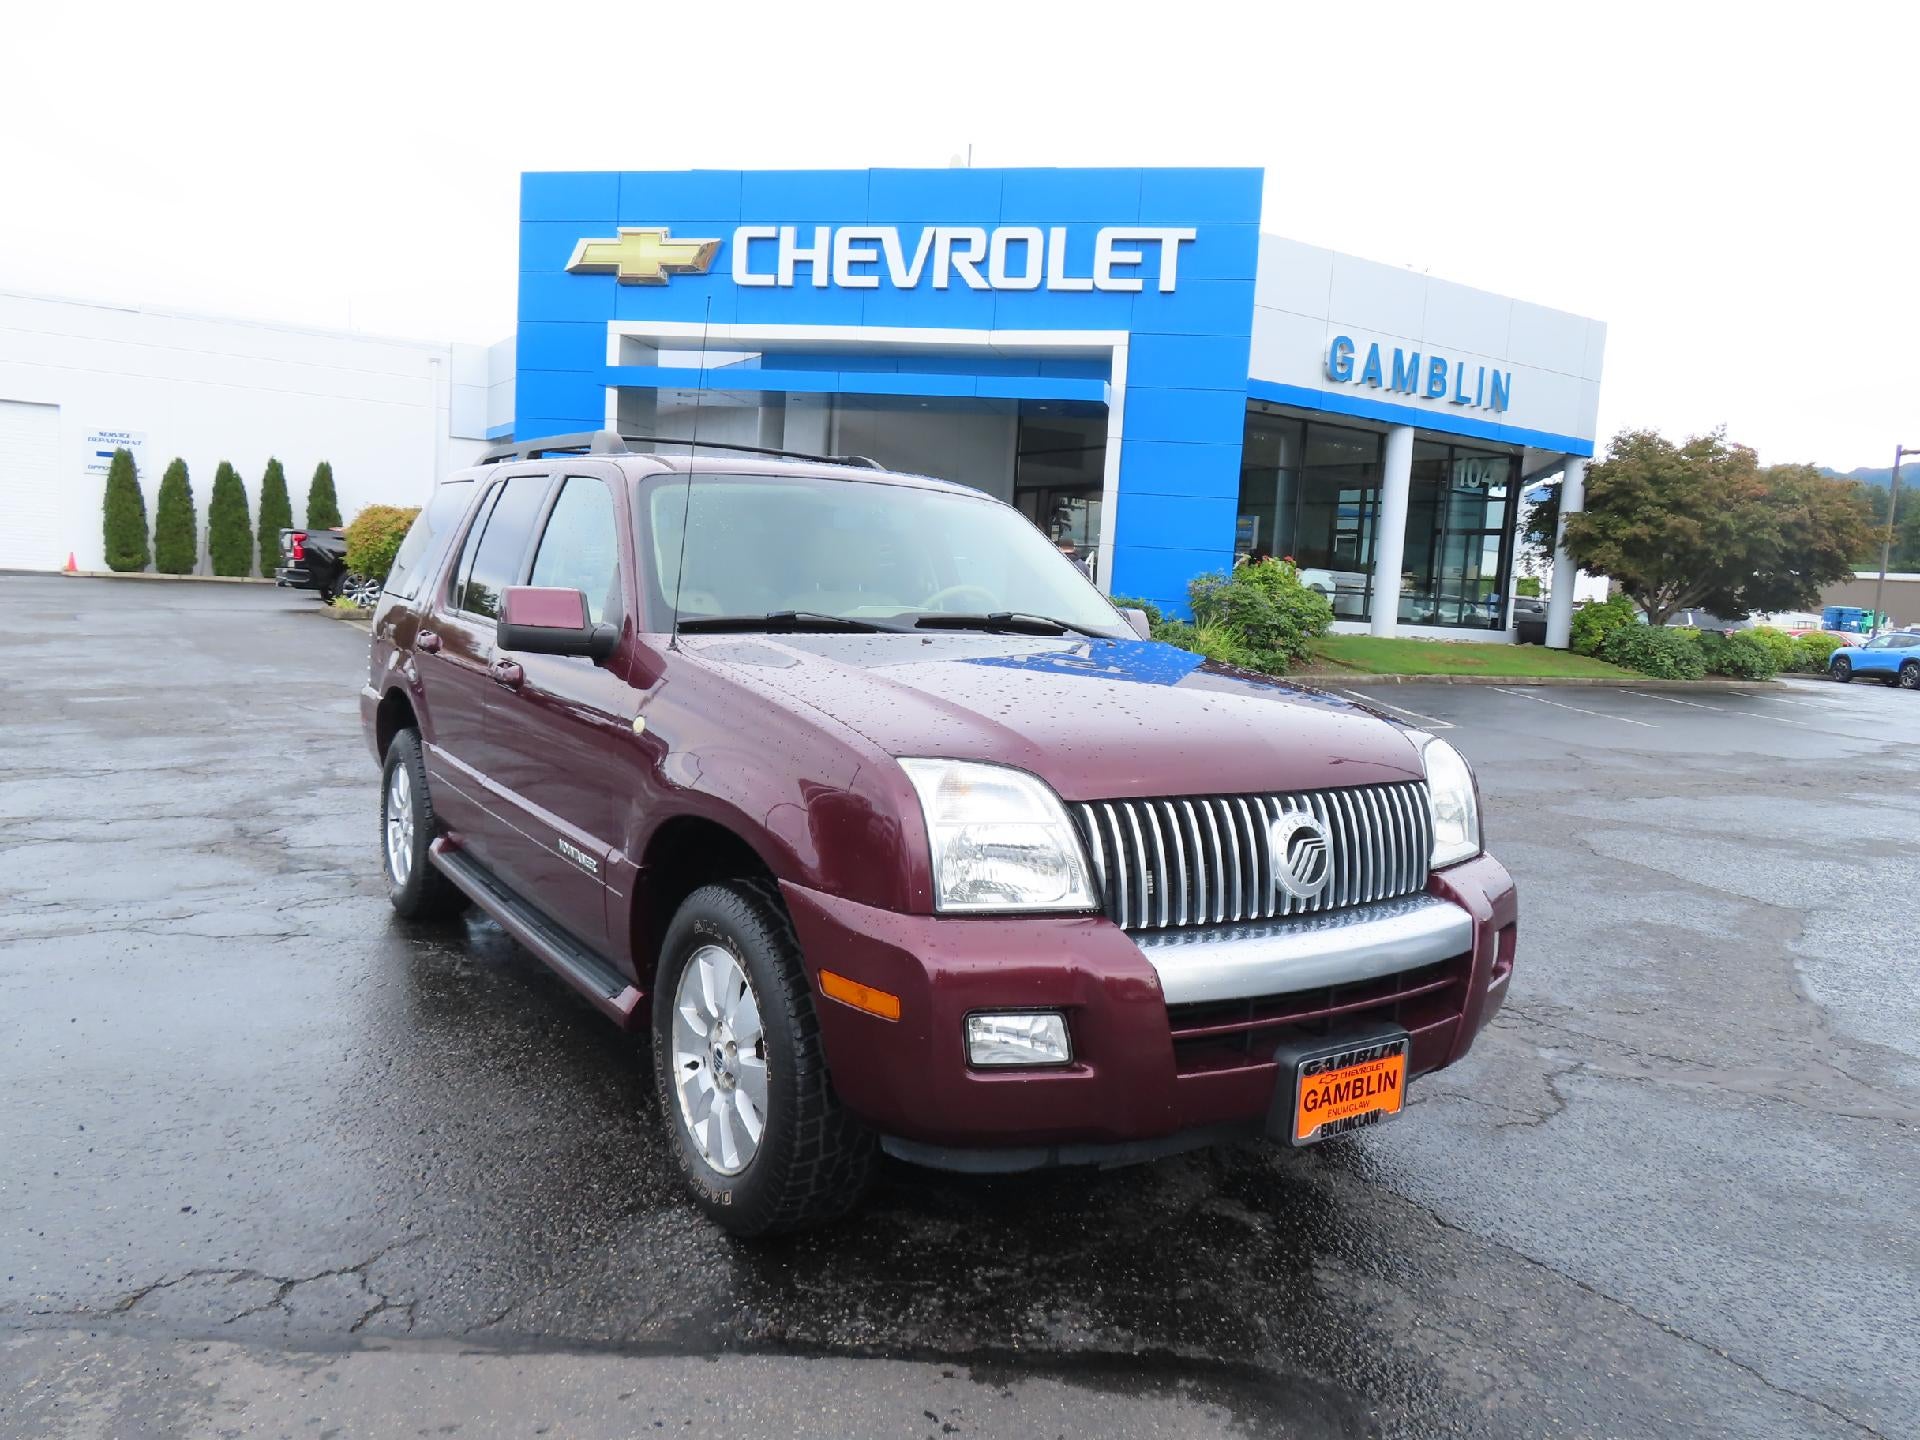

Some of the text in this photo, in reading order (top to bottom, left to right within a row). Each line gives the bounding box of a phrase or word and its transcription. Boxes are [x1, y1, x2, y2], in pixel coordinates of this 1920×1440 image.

[732, 225, 1198, 293] CHEVROLET
[1326, 335, 1512, 412] GAMBLIN
[1303, 1040, 1406, 1076] GAMBLIN
[1340, 1062, 1386, 1080] CHEVROLET
[1303, 1069, 1398, 1113] GAMBLIN
[1327, 1099, 1371, 1119] ENUMCLAW
[1320, 1108, 1381, 1139] ENUMCLAW
